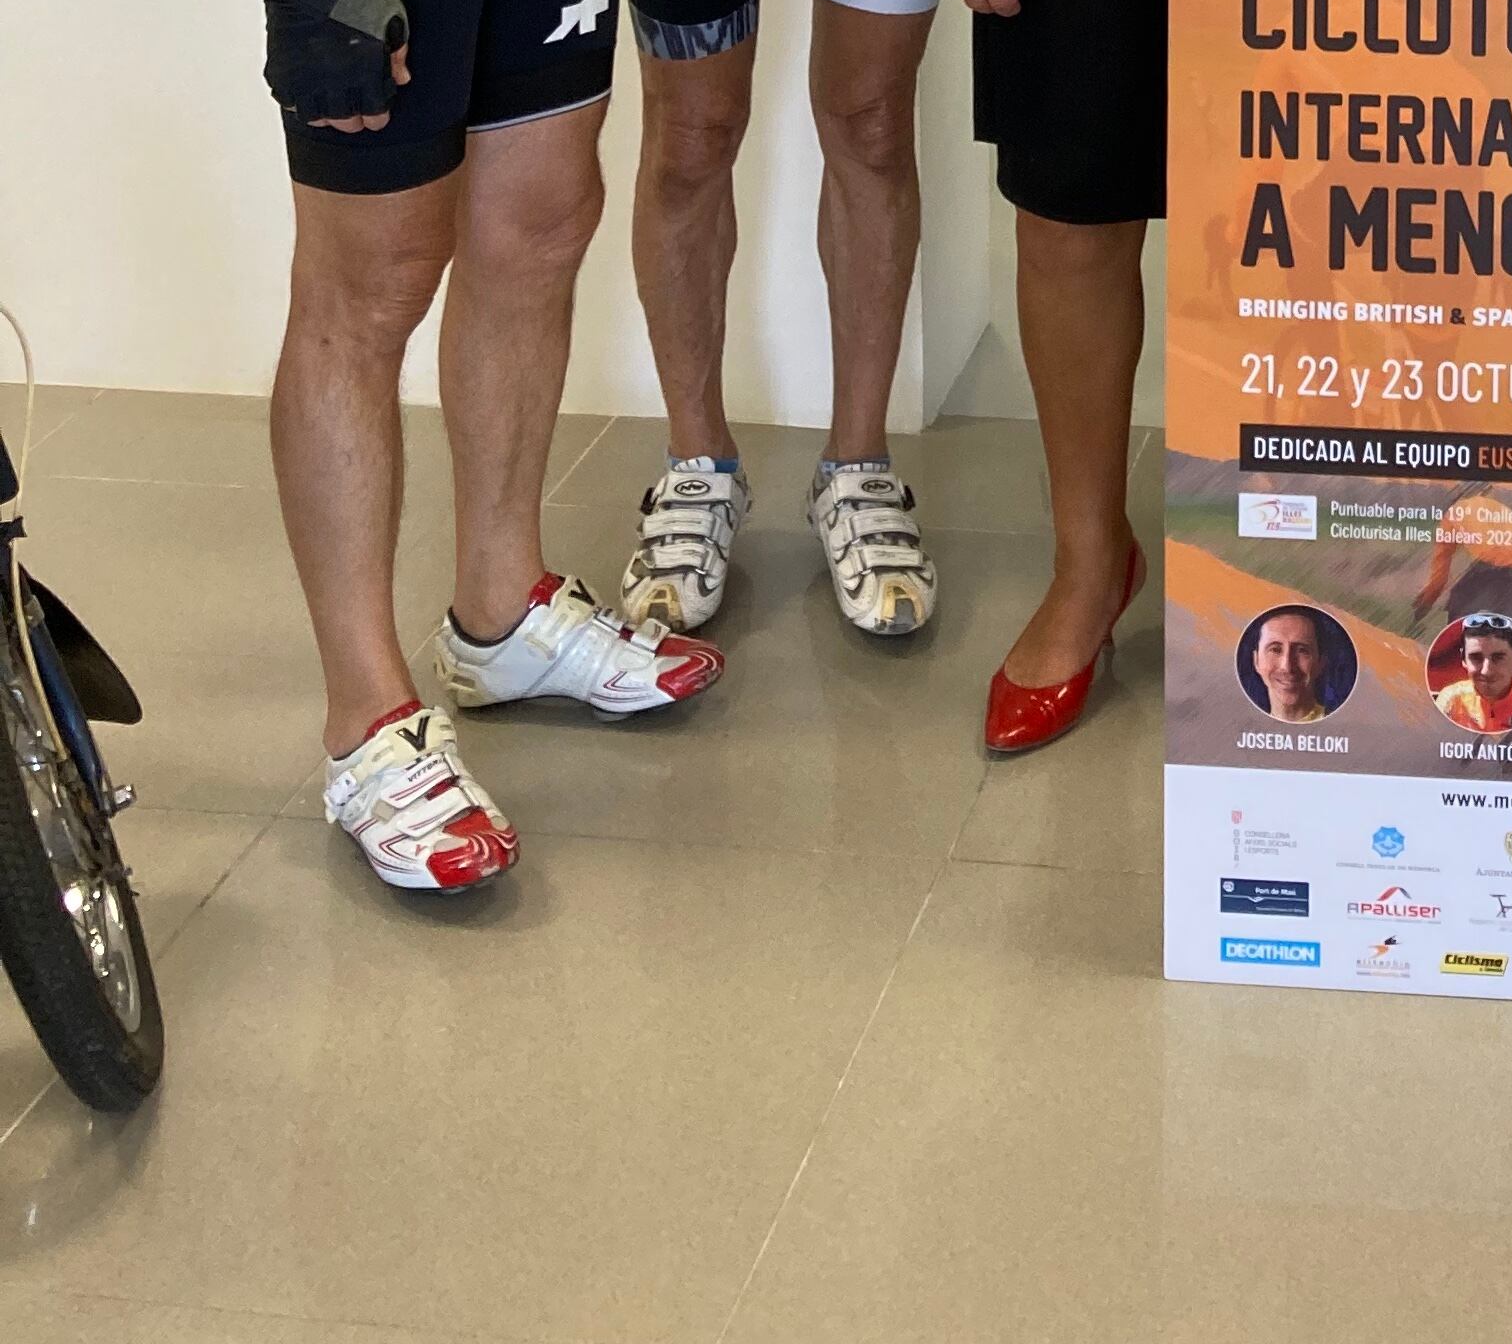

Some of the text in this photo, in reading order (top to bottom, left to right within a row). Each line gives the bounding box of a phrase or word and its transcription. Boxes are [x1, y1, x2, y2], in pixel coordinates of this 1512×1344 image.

[1239, 183, 1295, 270] A
[1238, 297, 1349, 322] BRINGING
[1354, 303, 1444, 326] BRITISH
[1449, 307, 1467, 327] &
[1241, 352, 1285, 399] 21,
[1297, 355, 1341, 398] 22
[1348, 367, 1371, 408] y
[1381, 359, 1424, 402] 23
[1253, 436, 1357, 464] DEDICADA
[1362, 441, 1389, 465] AL
[1394, 442, 1472, 470] EQUIPO
[1330, 501, 1394, 520] Puntuable
[1398, 507, 1427, 523] para
[1431, 504, 1443, 520] la
[1330, 522, 1402, 542] Cicloturista
[1405, 526, 1432, 543] Illes
[1436, 528, 1483, 545] Balears
[1237, 731, 1349, 753] JOSEBA BELOKI
[1439, 741, 1473, 760] IGOR
[1226, 942, 1316, 962] DECATHLON
